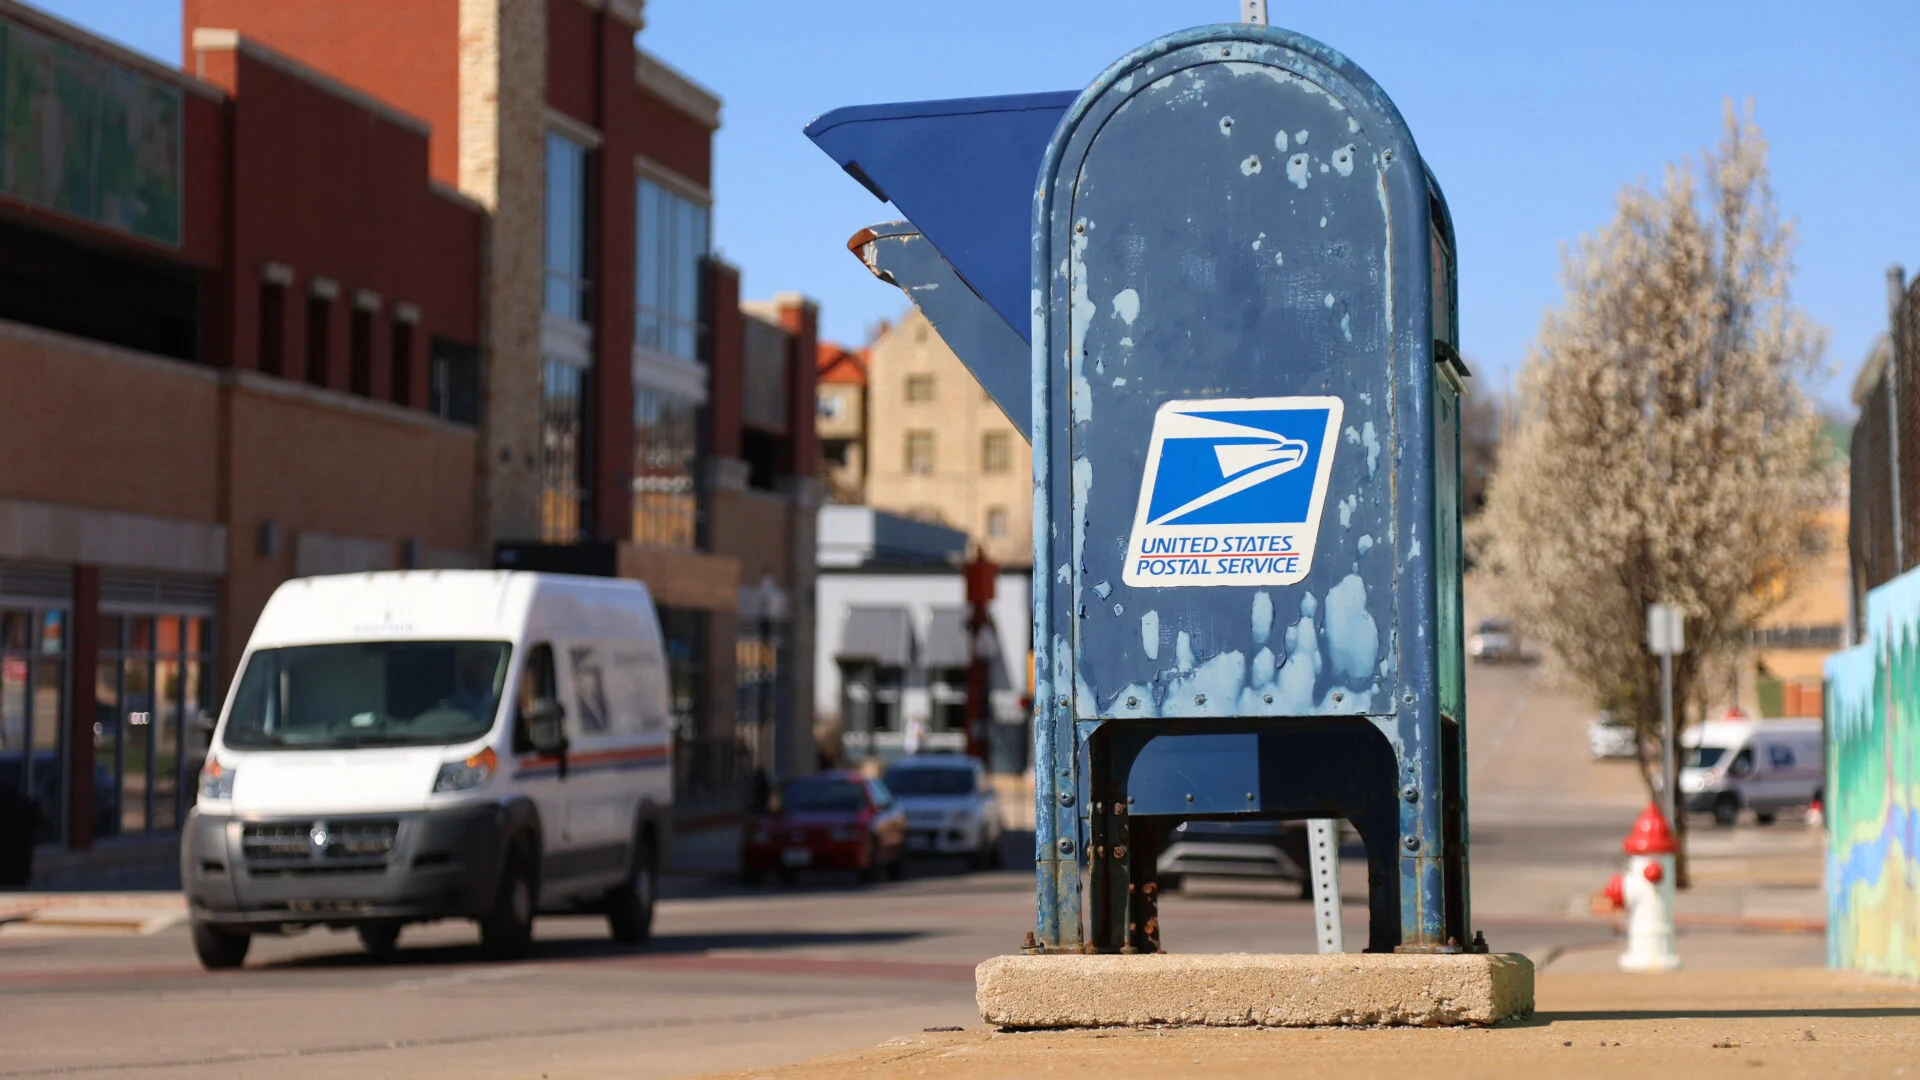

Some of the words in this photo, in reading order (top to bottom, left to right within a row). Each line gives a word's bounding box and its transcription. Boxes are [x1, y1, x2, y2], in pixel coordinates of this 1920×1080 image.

[1141, 537, 1218, 553] UNITED
[1221, 535, 1293, 552] STATES
[1136, 559, 1211, 575] POSTAL
[1216, 557, 1299, 574] SERVICE
